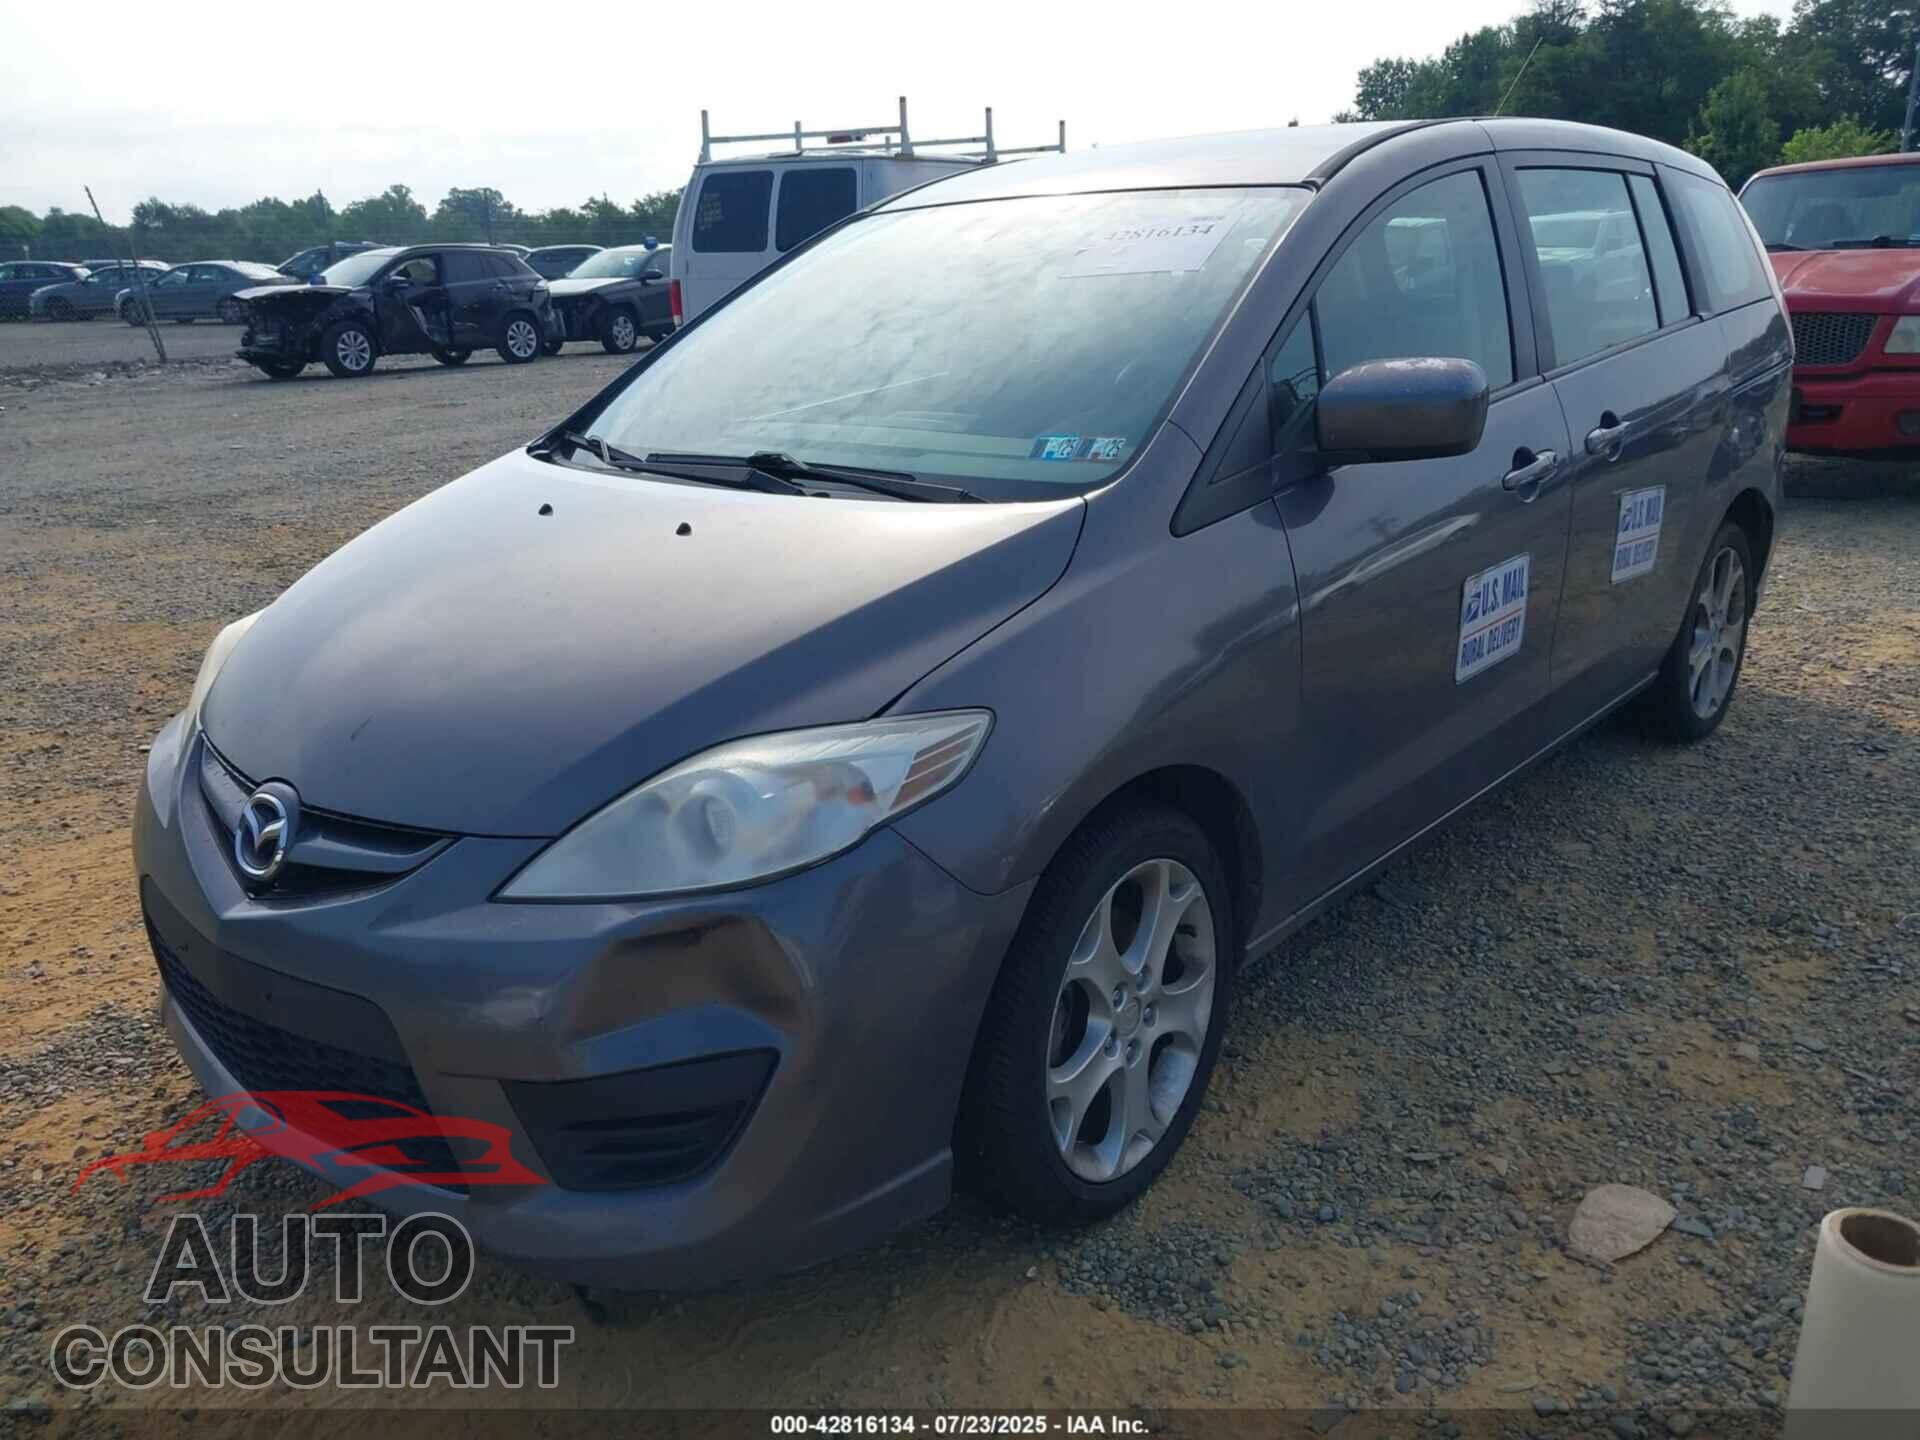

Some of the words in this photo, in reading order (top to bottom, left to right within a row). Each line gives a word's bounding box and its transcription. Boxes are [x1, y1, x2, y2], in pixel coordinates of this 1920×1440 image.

[1481, 577, 1499, 617] U.S.
[1502, 565, 1525, 607] MAIL
[1461, 635, 1485, 668] RURAL
[1486, 615, 1521, 655] DELIVERY
